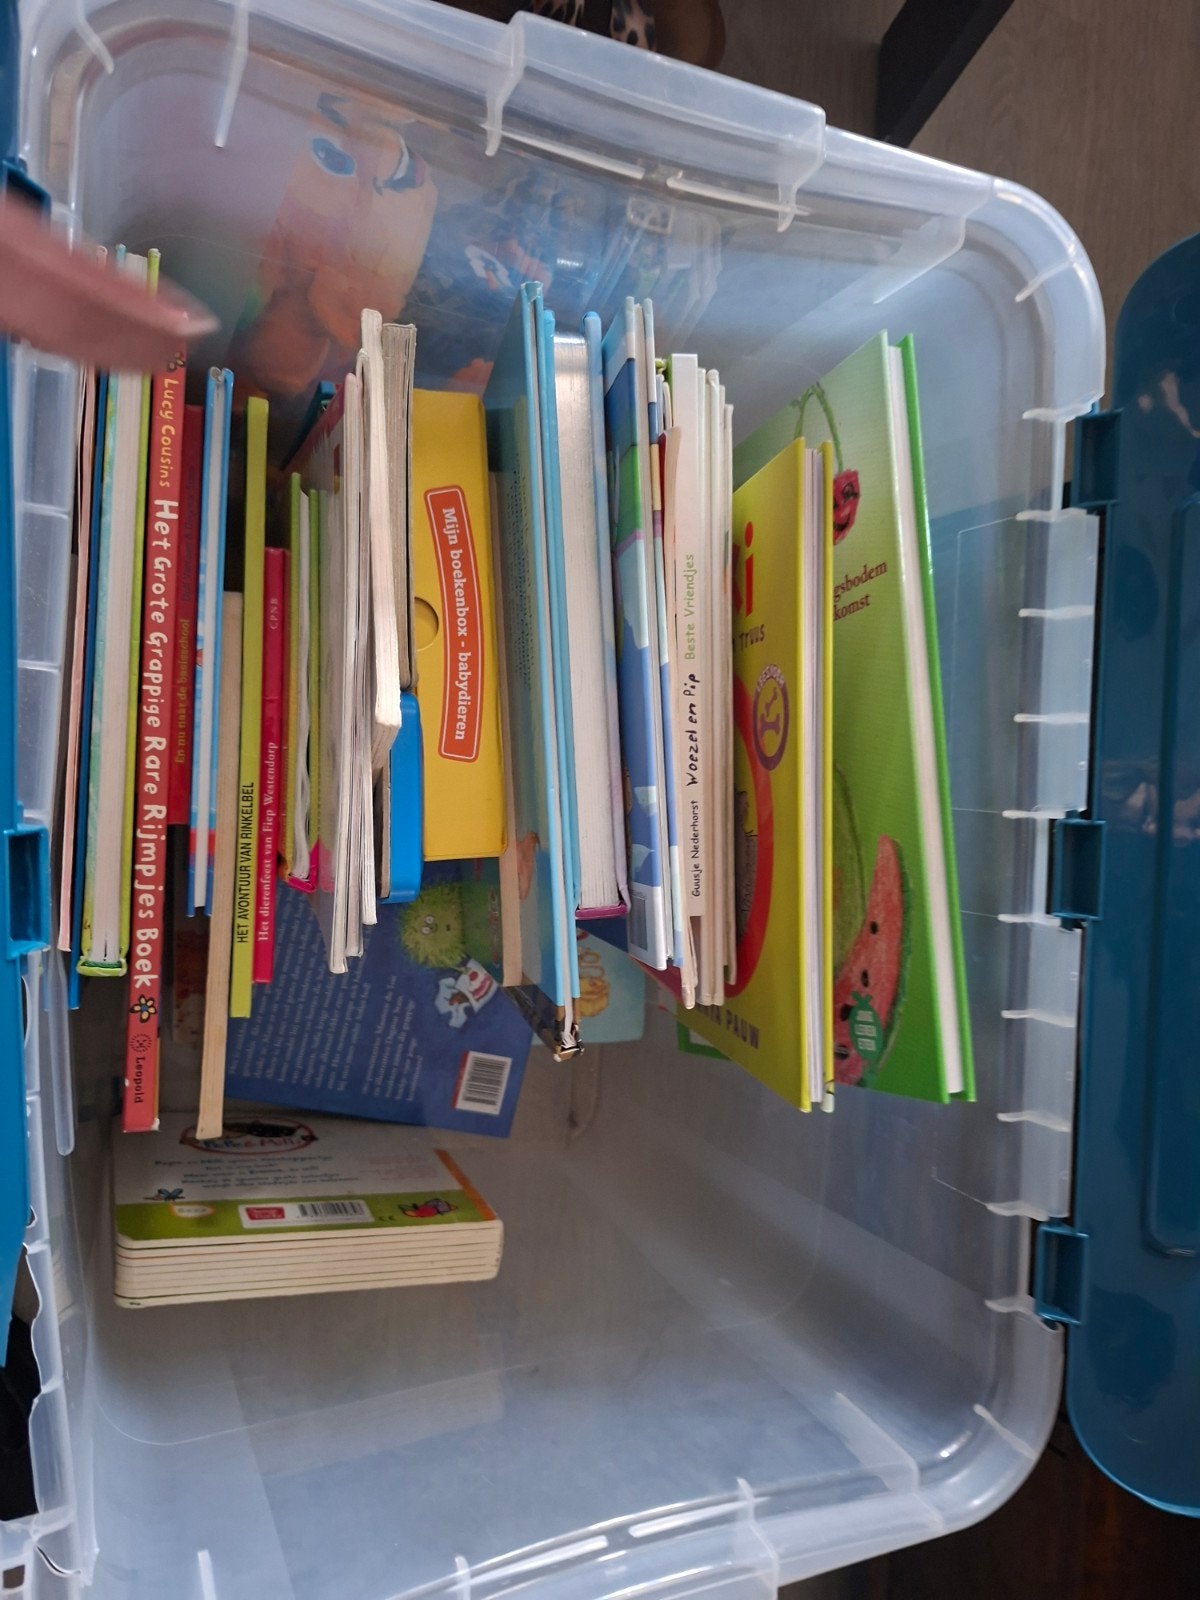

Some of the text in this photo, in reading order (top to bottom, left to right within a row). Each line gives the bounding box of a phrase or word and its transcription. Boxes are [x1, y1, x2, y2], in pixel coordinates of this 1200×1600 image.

[158, 378, 180, 488] Lucy Cousins
[441, 506, 460, 546] Mijn
[450, 548, 470, 637] boekenbox
[683, 553, 698, 660] Beste Vriendjes
[453, 651, 472, 741] babydieren
[683, 672, 701, 787] Woezel en Pip
[134, 499, 179, 988] Het Grote Grappige Rare Rijmpjes Boek
[263, 741, 279, 806] Westendorp
[237, 782, 254, 943] HET AVONTUUR VAN RINKELBEL
[262, 809, 277, 832] Fiep
[691, 800, 703, 898] Guusje Nederhorst
[257, 921, 269, 942] Het
[259, 859, 272, 917] dierenfeest
[133, 1055, 146, 1104] Leopold
